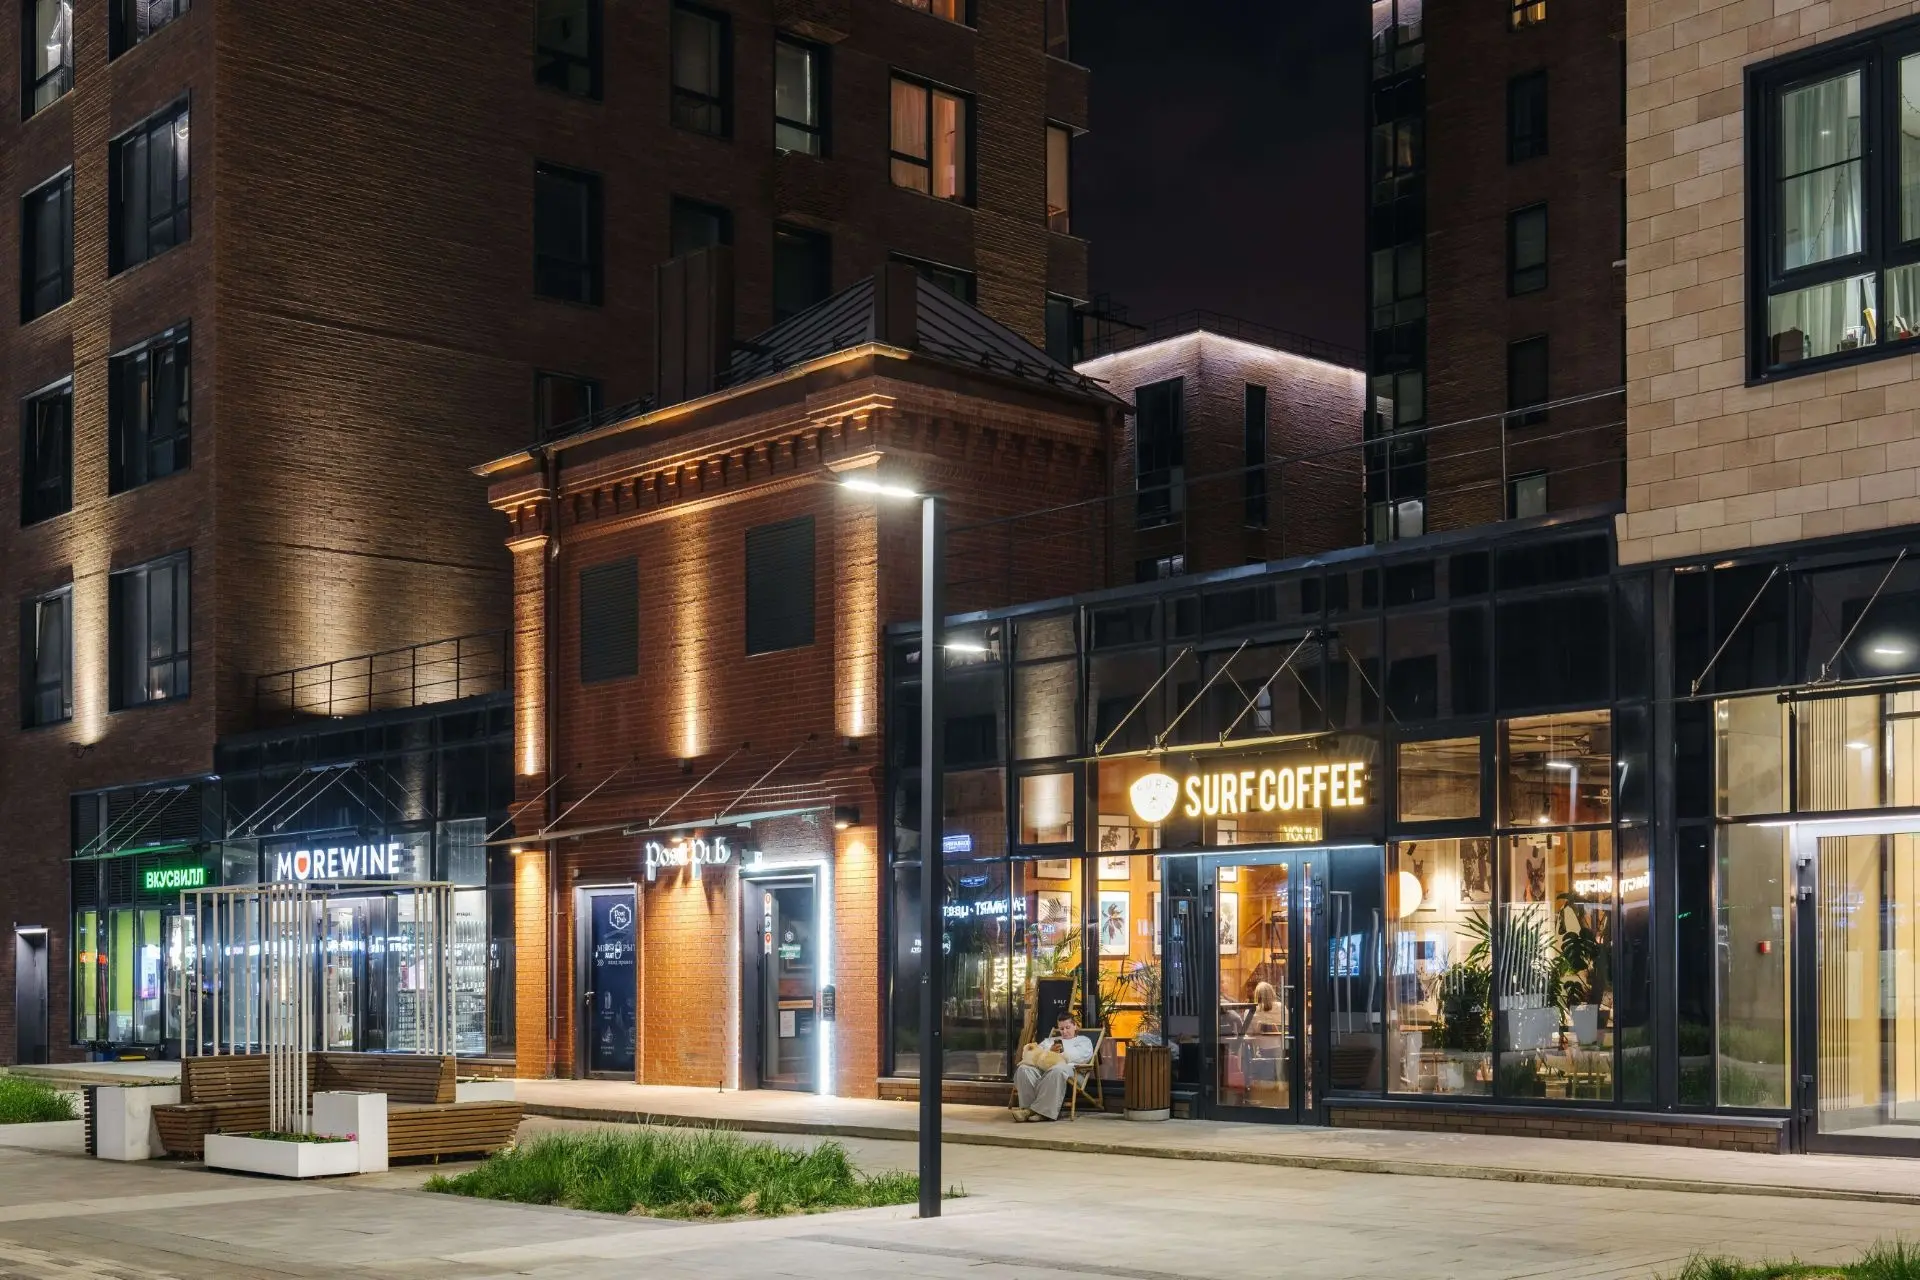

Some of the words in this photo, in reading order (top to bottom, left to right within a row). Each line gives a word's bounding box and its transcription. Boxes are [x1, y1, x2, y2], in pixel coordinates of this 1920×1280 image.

[1185, 771, 1255, 817] SURF
[1259, 762, 1364, 812] COFFEE
[146, 867, 204, 889] ВКУСВИЛЛ
[277, 843, 401, 880] MOREWINE
